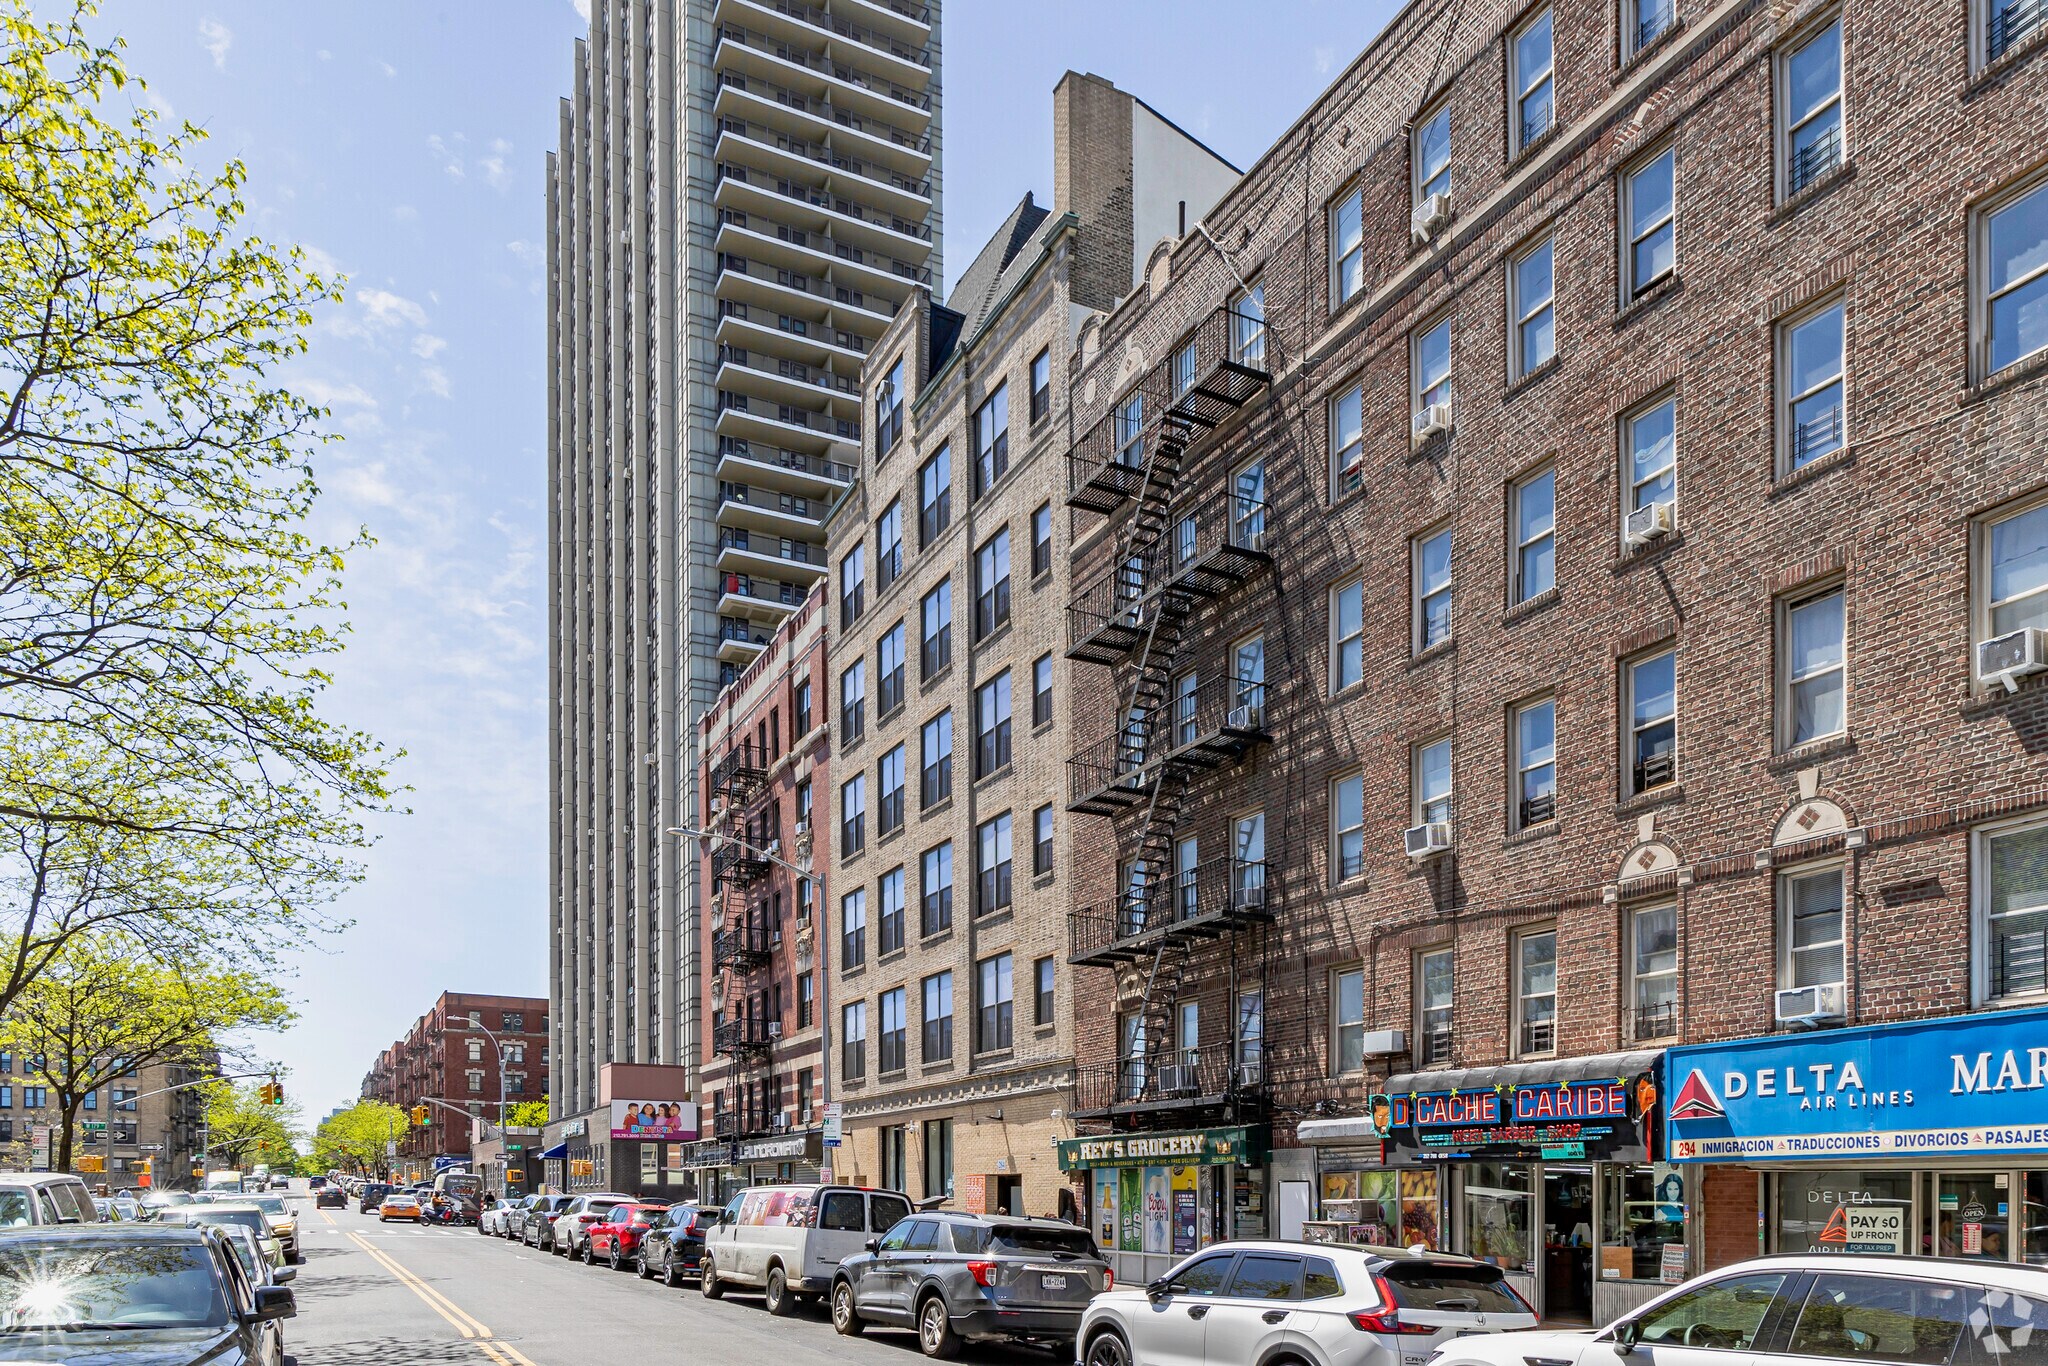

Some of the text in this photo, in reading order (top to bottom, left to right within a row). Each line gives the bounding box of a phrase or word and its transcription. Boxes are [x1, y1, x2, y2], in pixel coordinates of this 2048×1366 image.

[1724, 1061, 1865, 1099] DELTA
[1416, 1092, 1496, 1123] CACHE
[1516, 1084, 1625, 1118] CARIBE
[1800, 1090, 1914, 1110] AIR LINES
[1490, 1125, 1536, 1141] BARBER
[1546, 1123, 1582, 1139] SHOP
[1080, 1134, 1204, 1160] REY'S GROCERY
[1678, 1141, 1696, 1156] 294
[1702, 1139, 1774, 1154] INMIGRACION
[1787, 1135, 1880, 1150] TRADUCCIONES
[1894, 1132, 1969, 1148] DIVORCIOS
[1808, 1191, 1873, 1204] DELTA
[1850, 1216, 1899, 1228] PAY $0
[1851, 1231, 1899, 1240] UP FRONT
